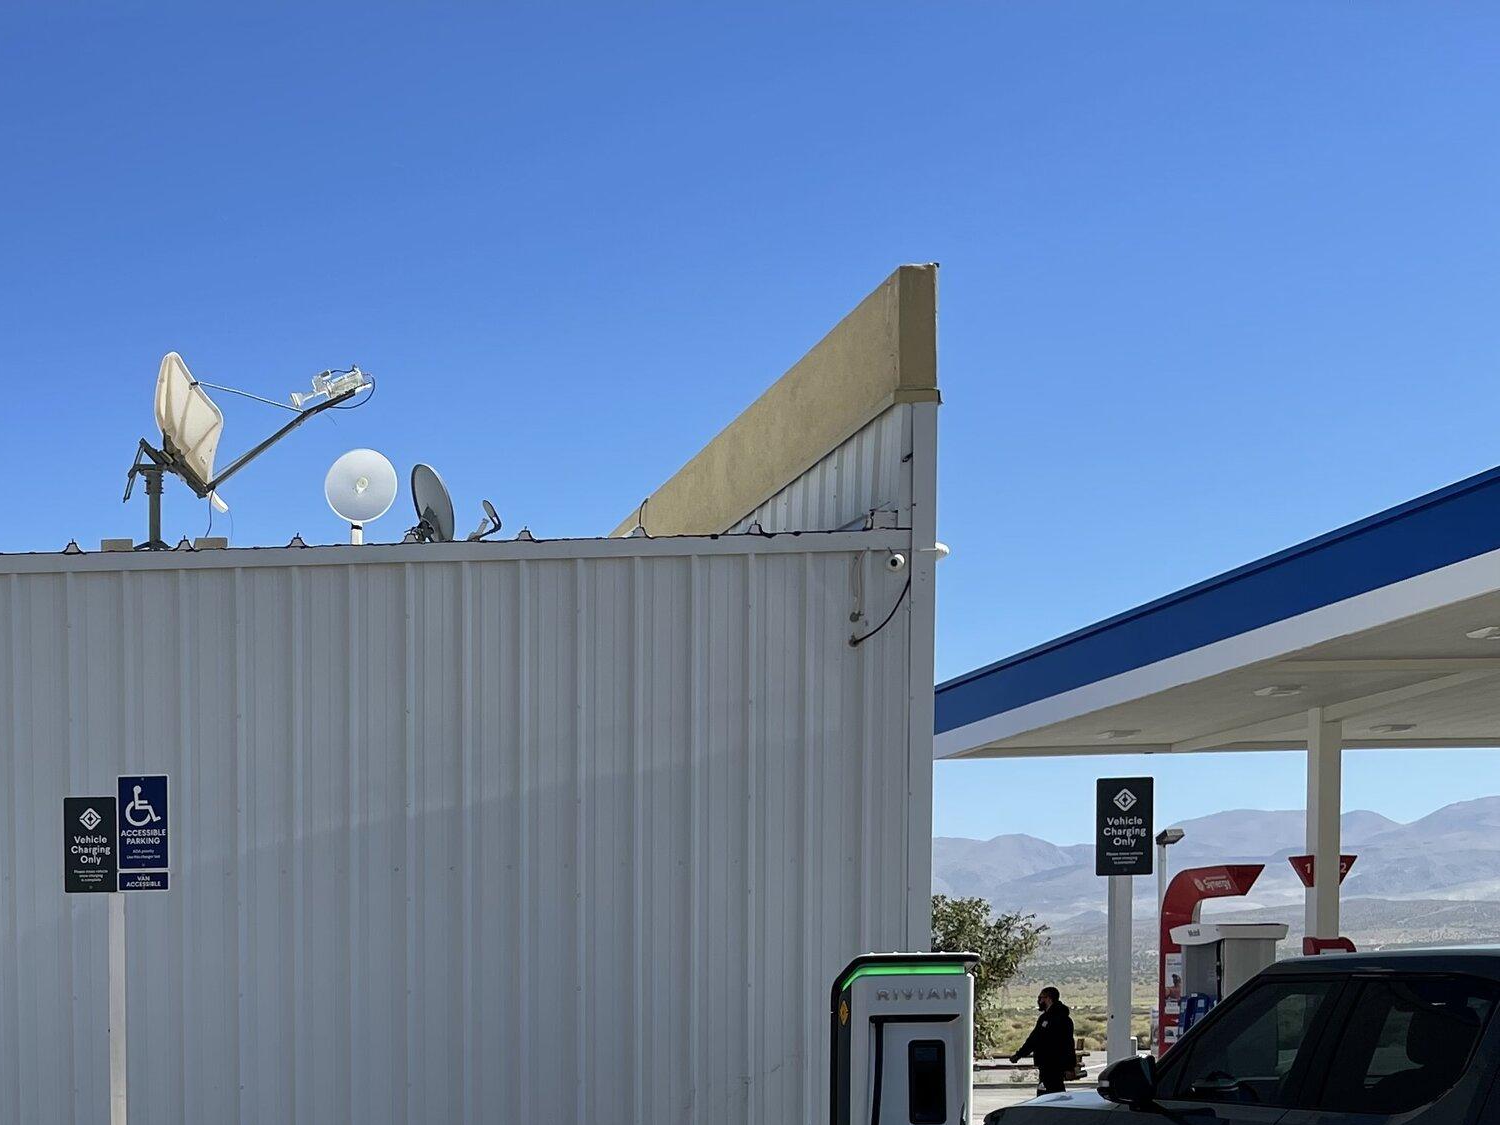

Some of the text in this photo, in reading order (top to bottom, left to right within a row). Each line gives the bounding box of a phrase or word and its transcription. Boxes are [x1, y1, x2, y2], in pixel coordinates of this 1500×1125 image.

[1106, 816, 1143, 826] Vehicle
[120, 828, 166, 837] ACCESSIBLE
[1103, 827, 1147, 837] Charging
[73, 835, 108, 844] Vehicle
[126, 837, 161, 845] PARKING
[1113, 838, 1137, 848] Only
[71, 845, 111, 855] Charging
[80, 855, 102, 865] Only
[1304, 863, 1311, 874] 1
[1340, 863, 1347, 873] 2
[876, 987, 958, 1001] RIVIAN
